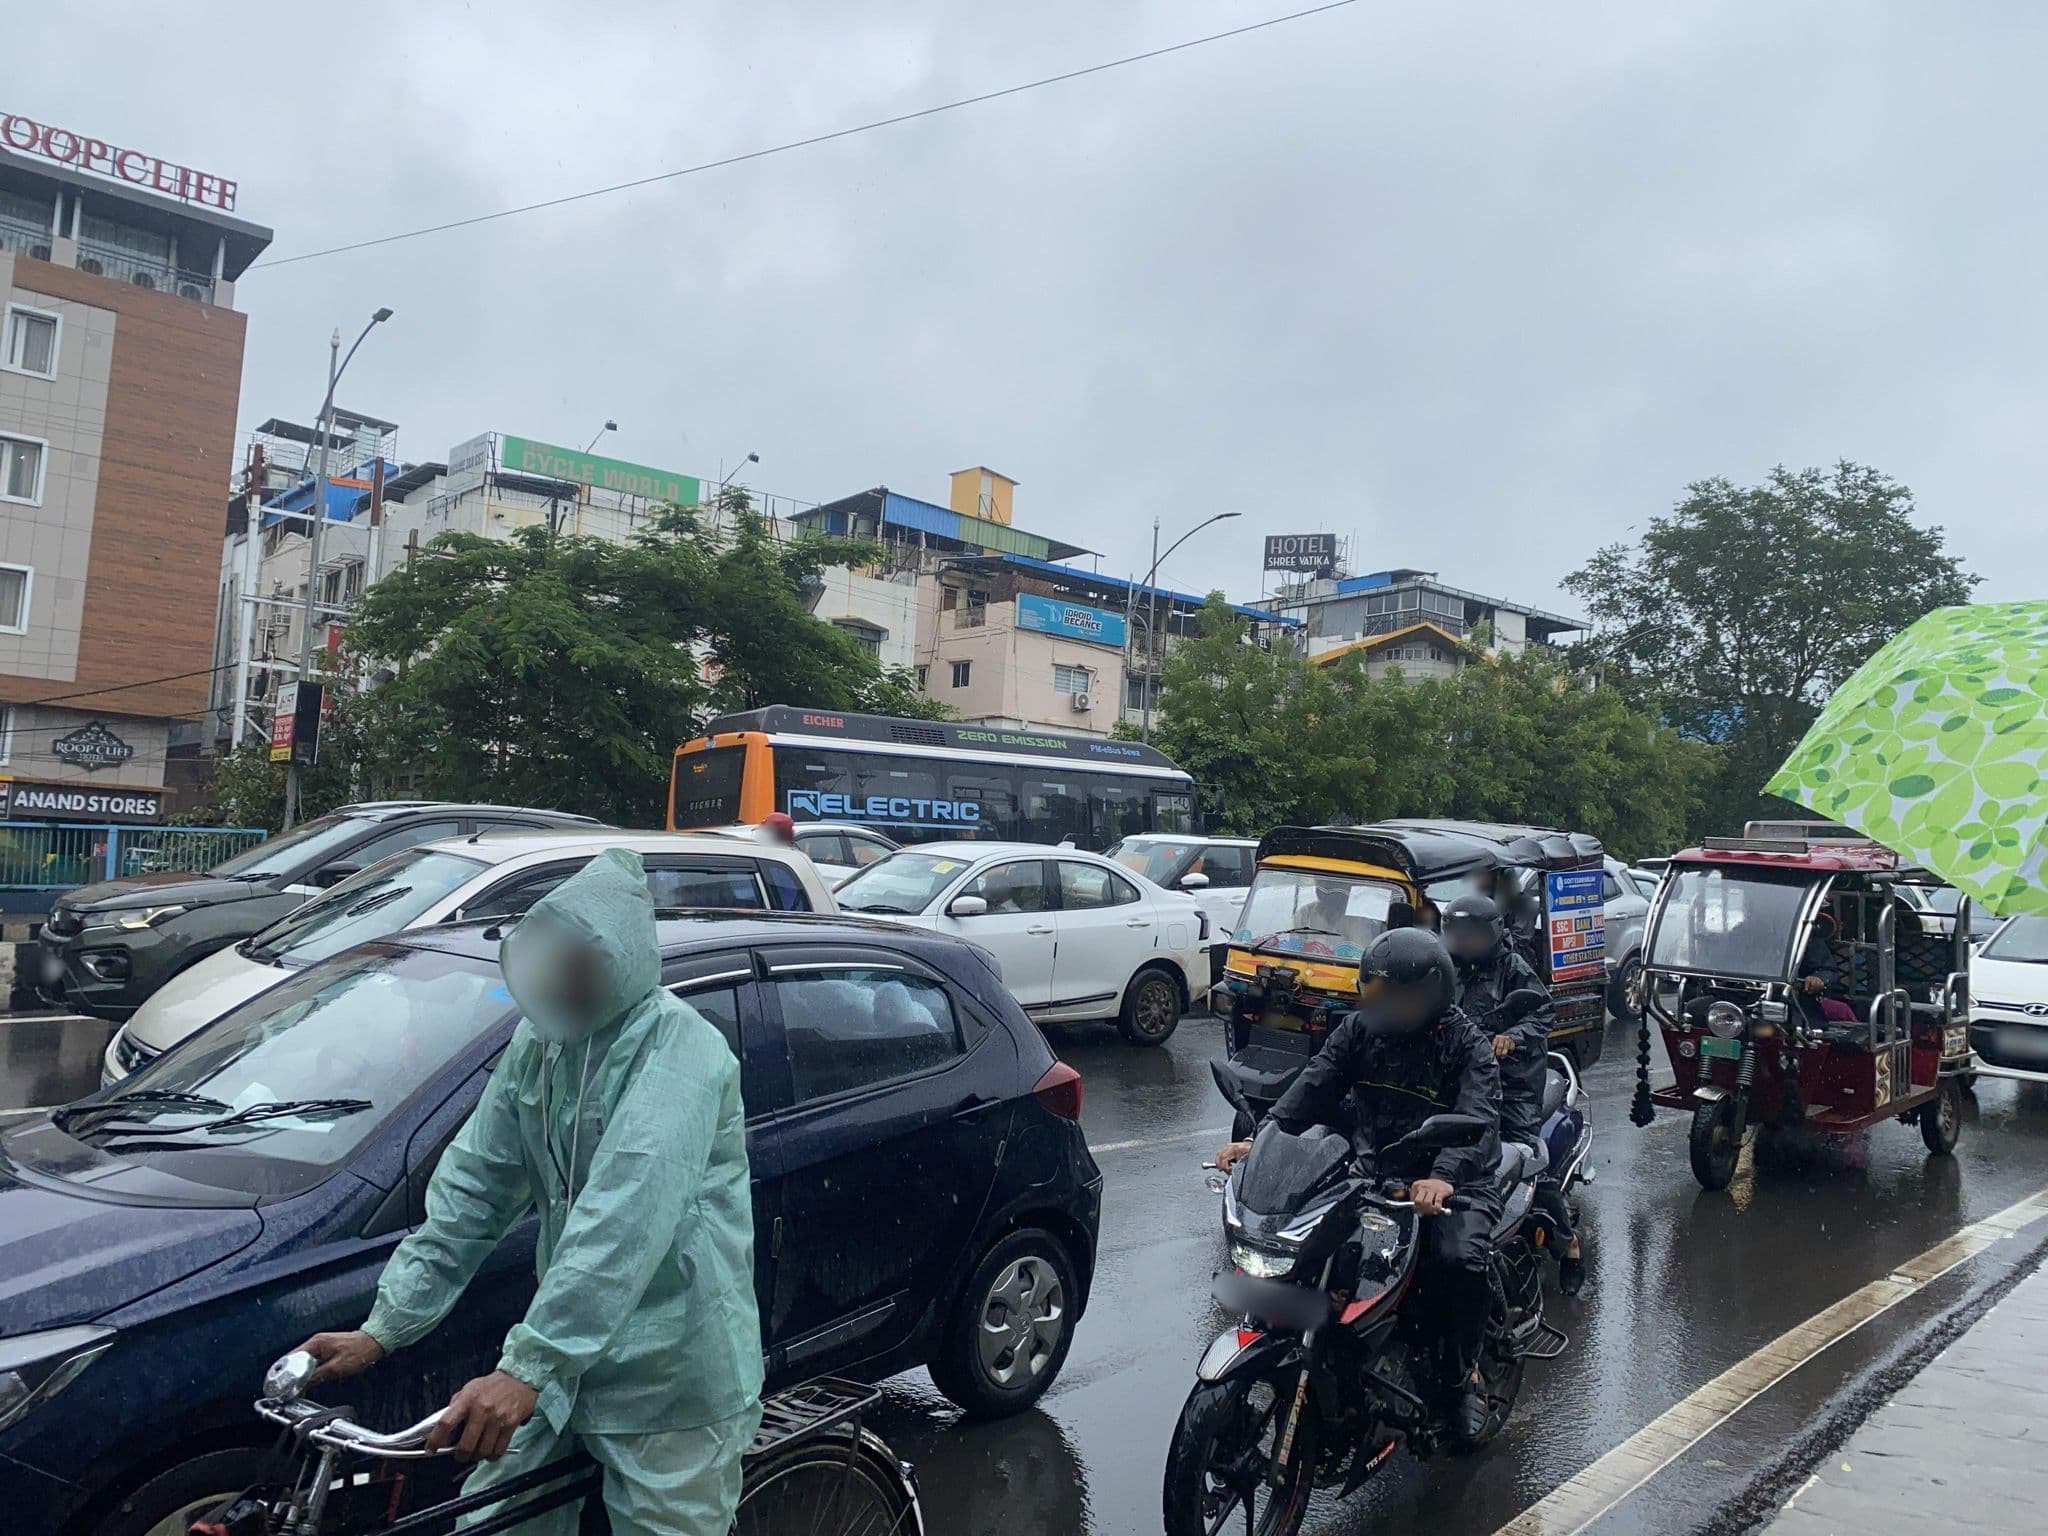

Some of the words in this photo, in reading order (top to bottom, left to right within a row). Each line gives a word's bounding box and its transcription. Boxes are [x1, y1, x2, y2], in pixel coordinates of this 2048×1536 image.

[0, 114, 108, 169] OOP
[116, 149, 238, 210] CLIFF
[522, 450, 595, 484] CYCLE
[603, 468, 679, 500] WORLD
[1271, 537, 1328, 554] HOTEL
[1268, 556, 1296, 566] SHREE
[1299, 555, 1330, 566] VATIKA
[803, 714, 844, 728] EICHER
[956, 730, 997, 743] ZERO
[1002, 734, 1067, 750] EMISSION
[56, 742, 94, 753] ROOP
[96, 745, 131, 757] CLIFF
[14, 790, 86, 811] ANAND
[88, 796, 157, 815] STORES
[821, 794, 979, 821] ELECTRIC
[1556, 920, 1569, 933] SSC
